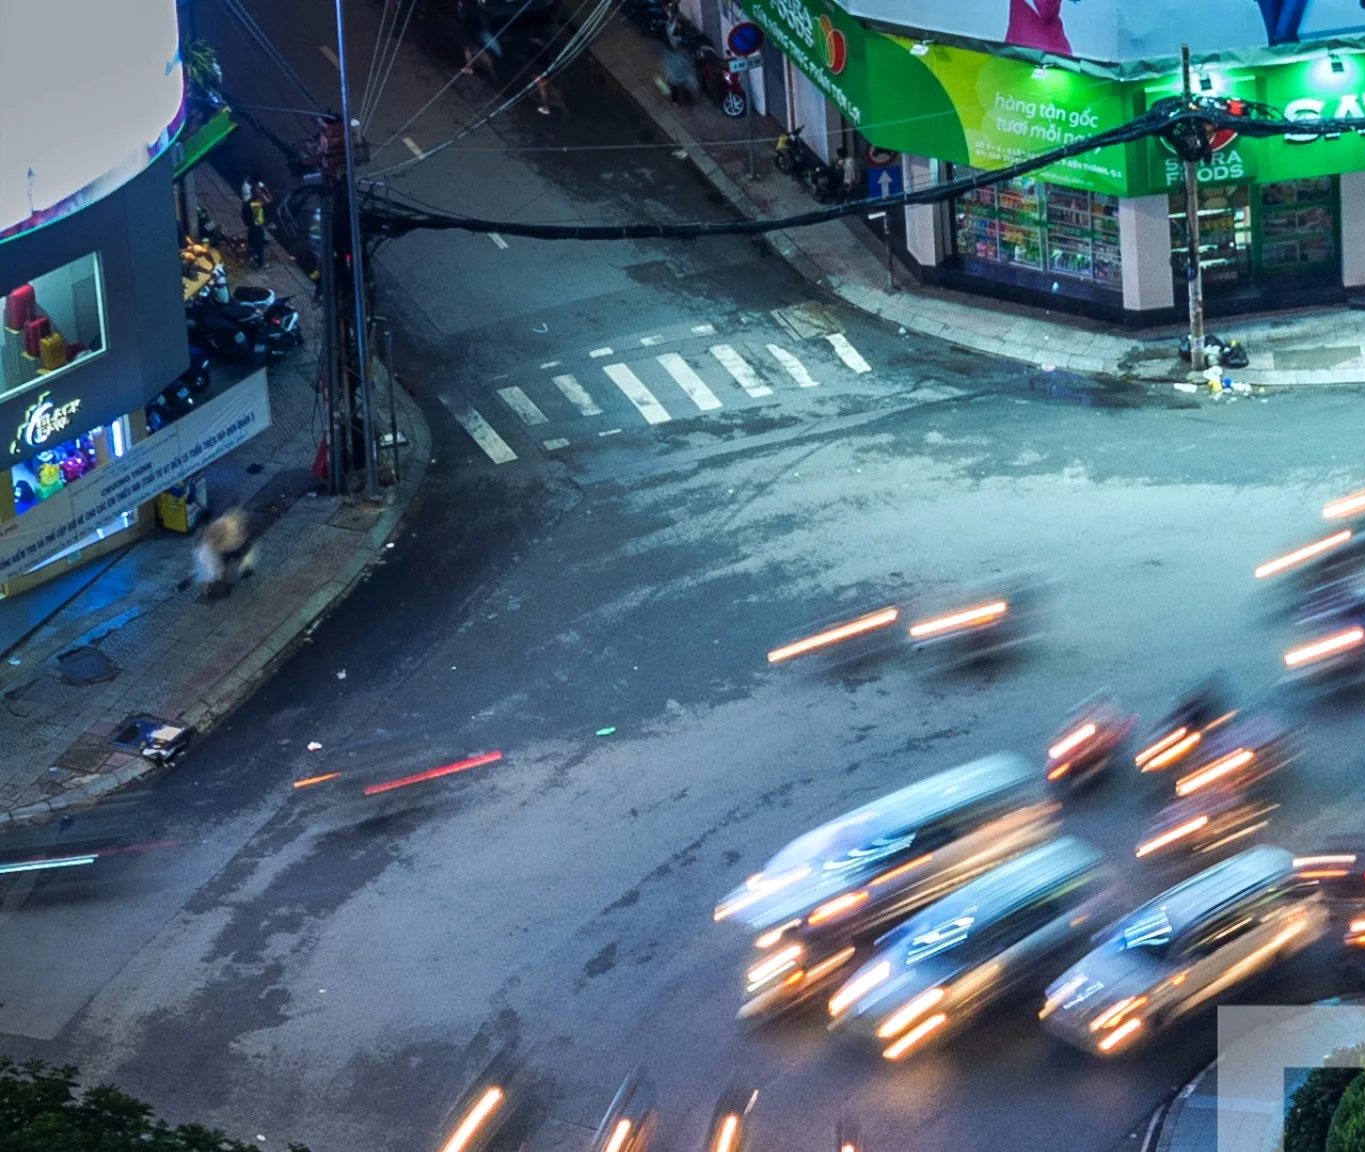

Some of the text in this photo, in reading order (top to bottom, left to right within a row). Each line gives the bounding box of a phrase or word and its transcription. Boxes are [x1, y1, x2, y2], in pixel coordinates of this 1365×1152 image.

[994, 92, 1099, 128] hàng tận gốc
[996, 116, 1028, 136] tươi
[1030, 124, 1061, 142] mỗi
[1165, 164, 1244, 186] FODS
